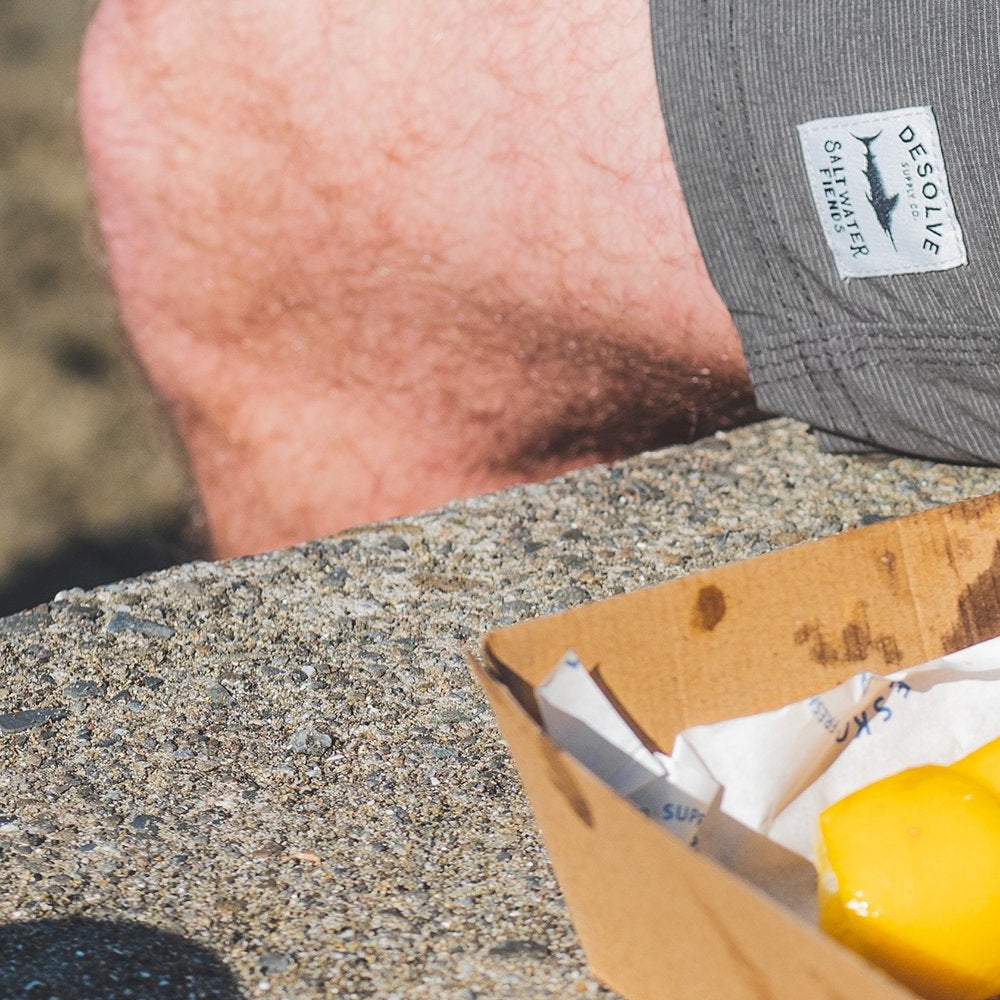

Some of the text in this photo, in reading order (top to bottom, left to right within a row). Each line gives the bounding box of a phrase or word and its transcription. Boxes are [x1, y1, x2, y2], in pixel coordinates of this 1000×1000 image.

[819, 168, 845, 233] FIENDS
[899, 125, 944, 255] DESOLVE
[901, 162, 915, 199] SUPPLY
